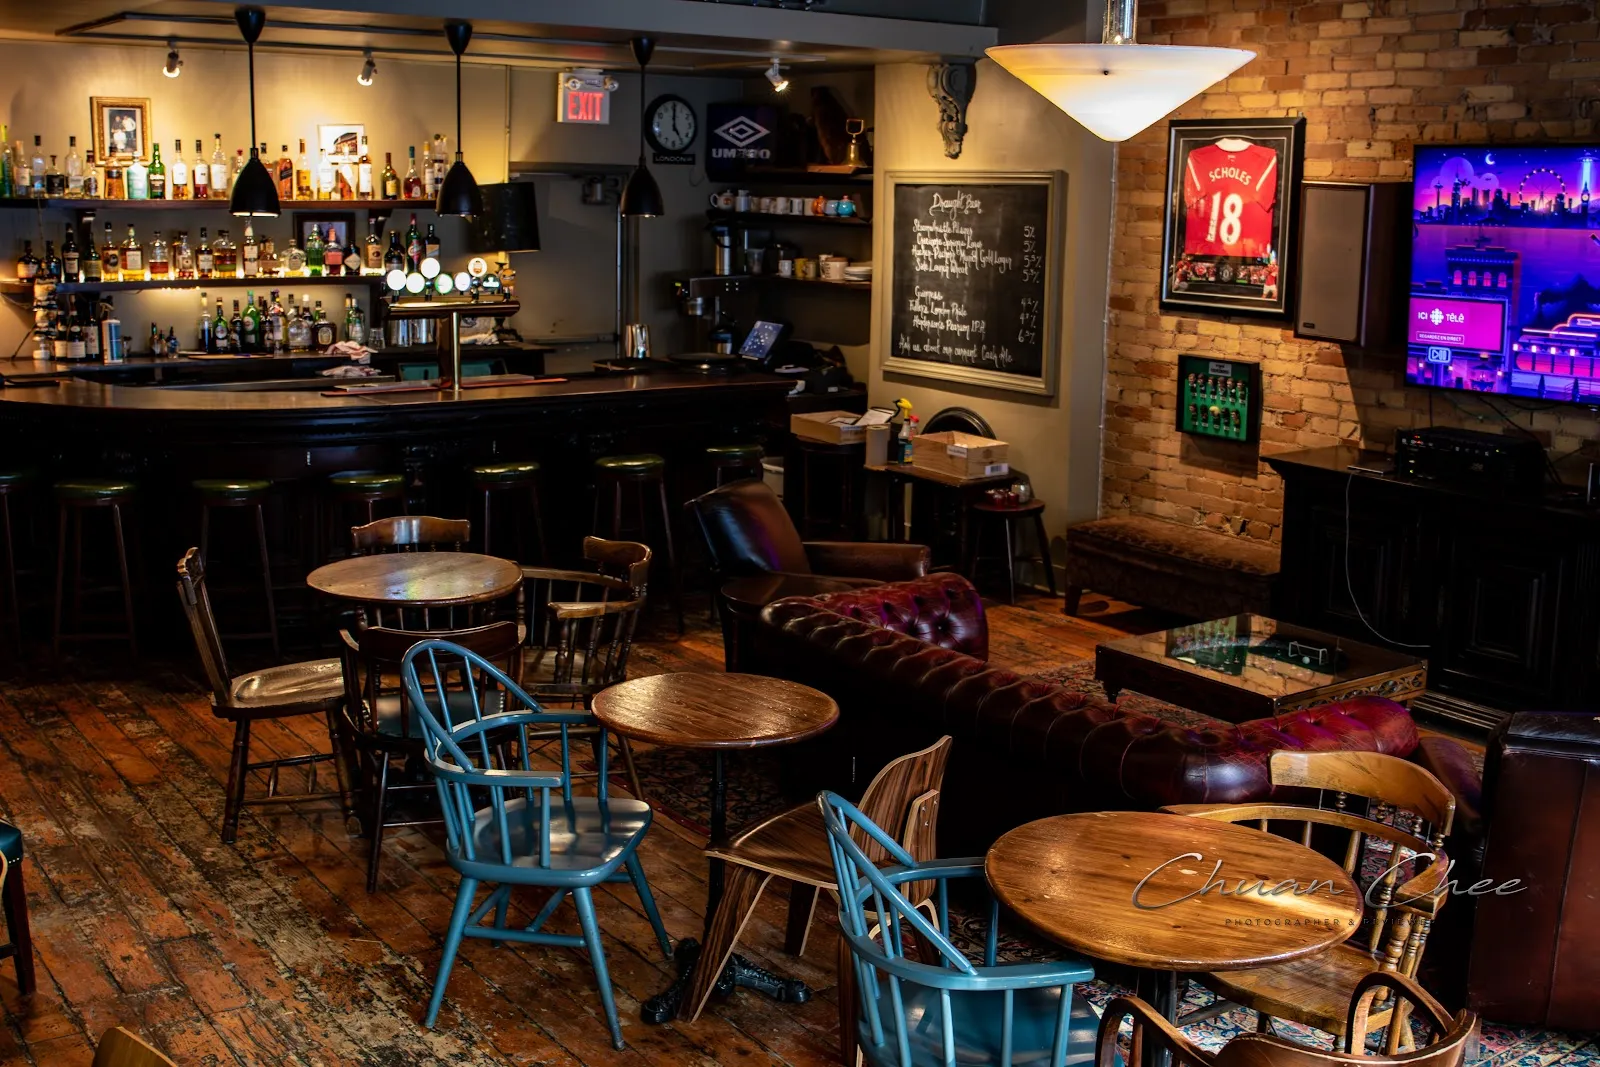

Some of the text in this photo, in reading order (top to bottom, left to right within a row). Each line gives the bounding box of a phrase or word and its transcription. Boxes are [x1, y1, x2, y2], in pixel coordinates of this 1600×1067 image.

[568, 92, 604, 121] EXIT
[1209, 167, 1252, 186] SCHOLES
[929, 190, 965, 220] Draught
[1205, 191, 1243, 245] 18
[1023, 225, 1036, 238] 5%
[1023, 240, 1037, 253] 5%
[931, 301, 951, 321] London
[1418, 312, 1428, 320] ICI
